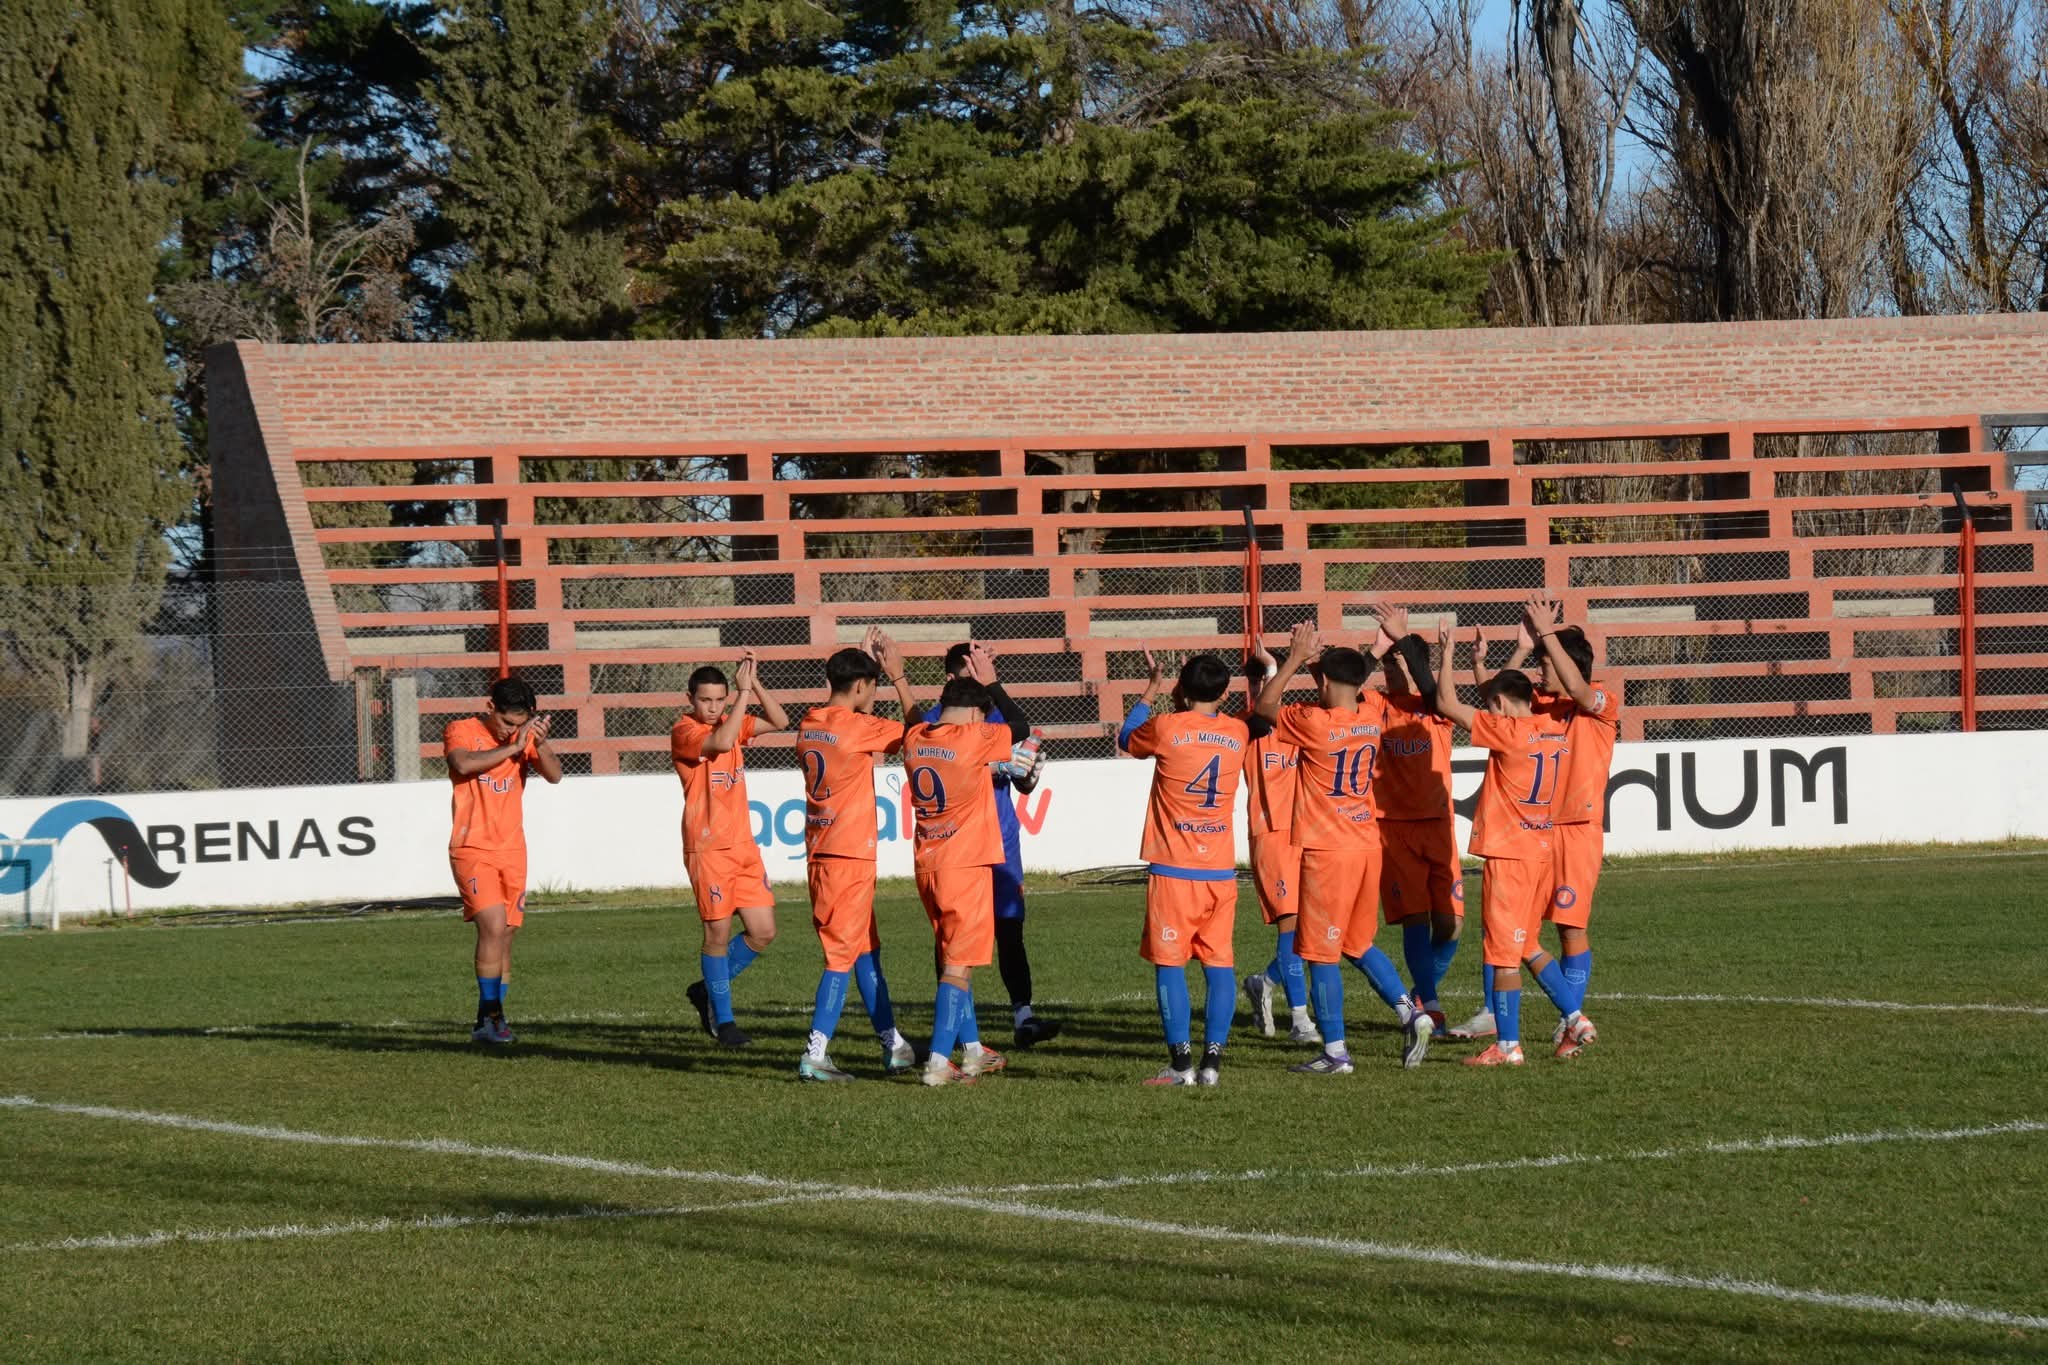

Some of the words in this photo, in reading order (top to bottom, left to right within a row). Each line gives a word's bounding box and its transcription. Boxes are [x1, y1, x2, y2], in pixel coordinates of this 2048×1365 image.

[803, 730, 838, 745] MORENO
[1198, 732, 1241, 752] MORENO
[917, 746, 956, 762] MORENO
[802, 749, 831, 802] 2
[1326, 742, 1378, 798] 10
[1519, 749, 1568, 805] 11
[1184, 753, 1224, 808] 4
[912, 765, 946, 818] 9
[468, 877, 478, 895] 7
[710, 884, 722, 903] 8
[1276, 879, 1288, 897] 3
